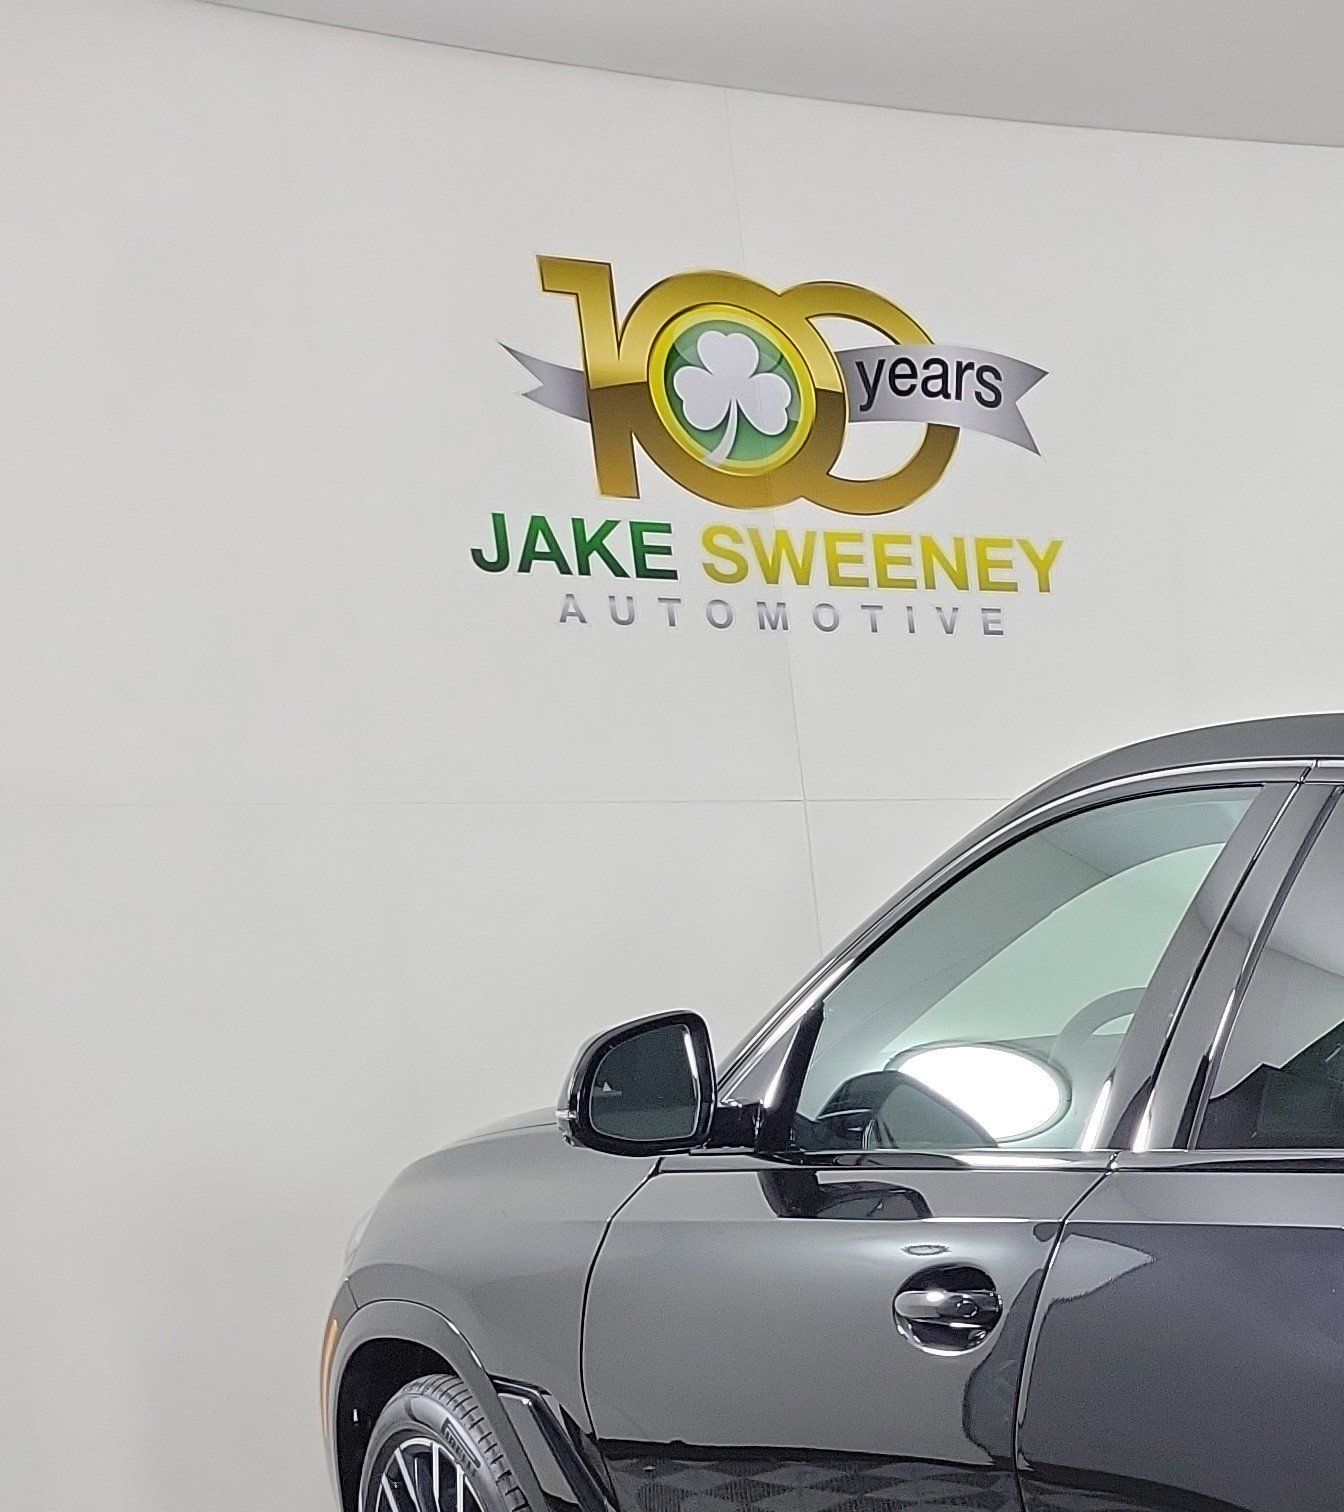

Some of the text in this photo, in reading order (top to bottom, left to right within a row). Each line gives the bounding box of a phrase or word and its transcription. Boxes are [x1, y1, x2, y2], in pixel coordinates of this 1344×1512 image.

[535, 253, 1003, 516] 100 years
[470, 511, 1065, 595] JAKE SWEENEY
[558, 593, 1006, 637] AUTOMOTIVE
